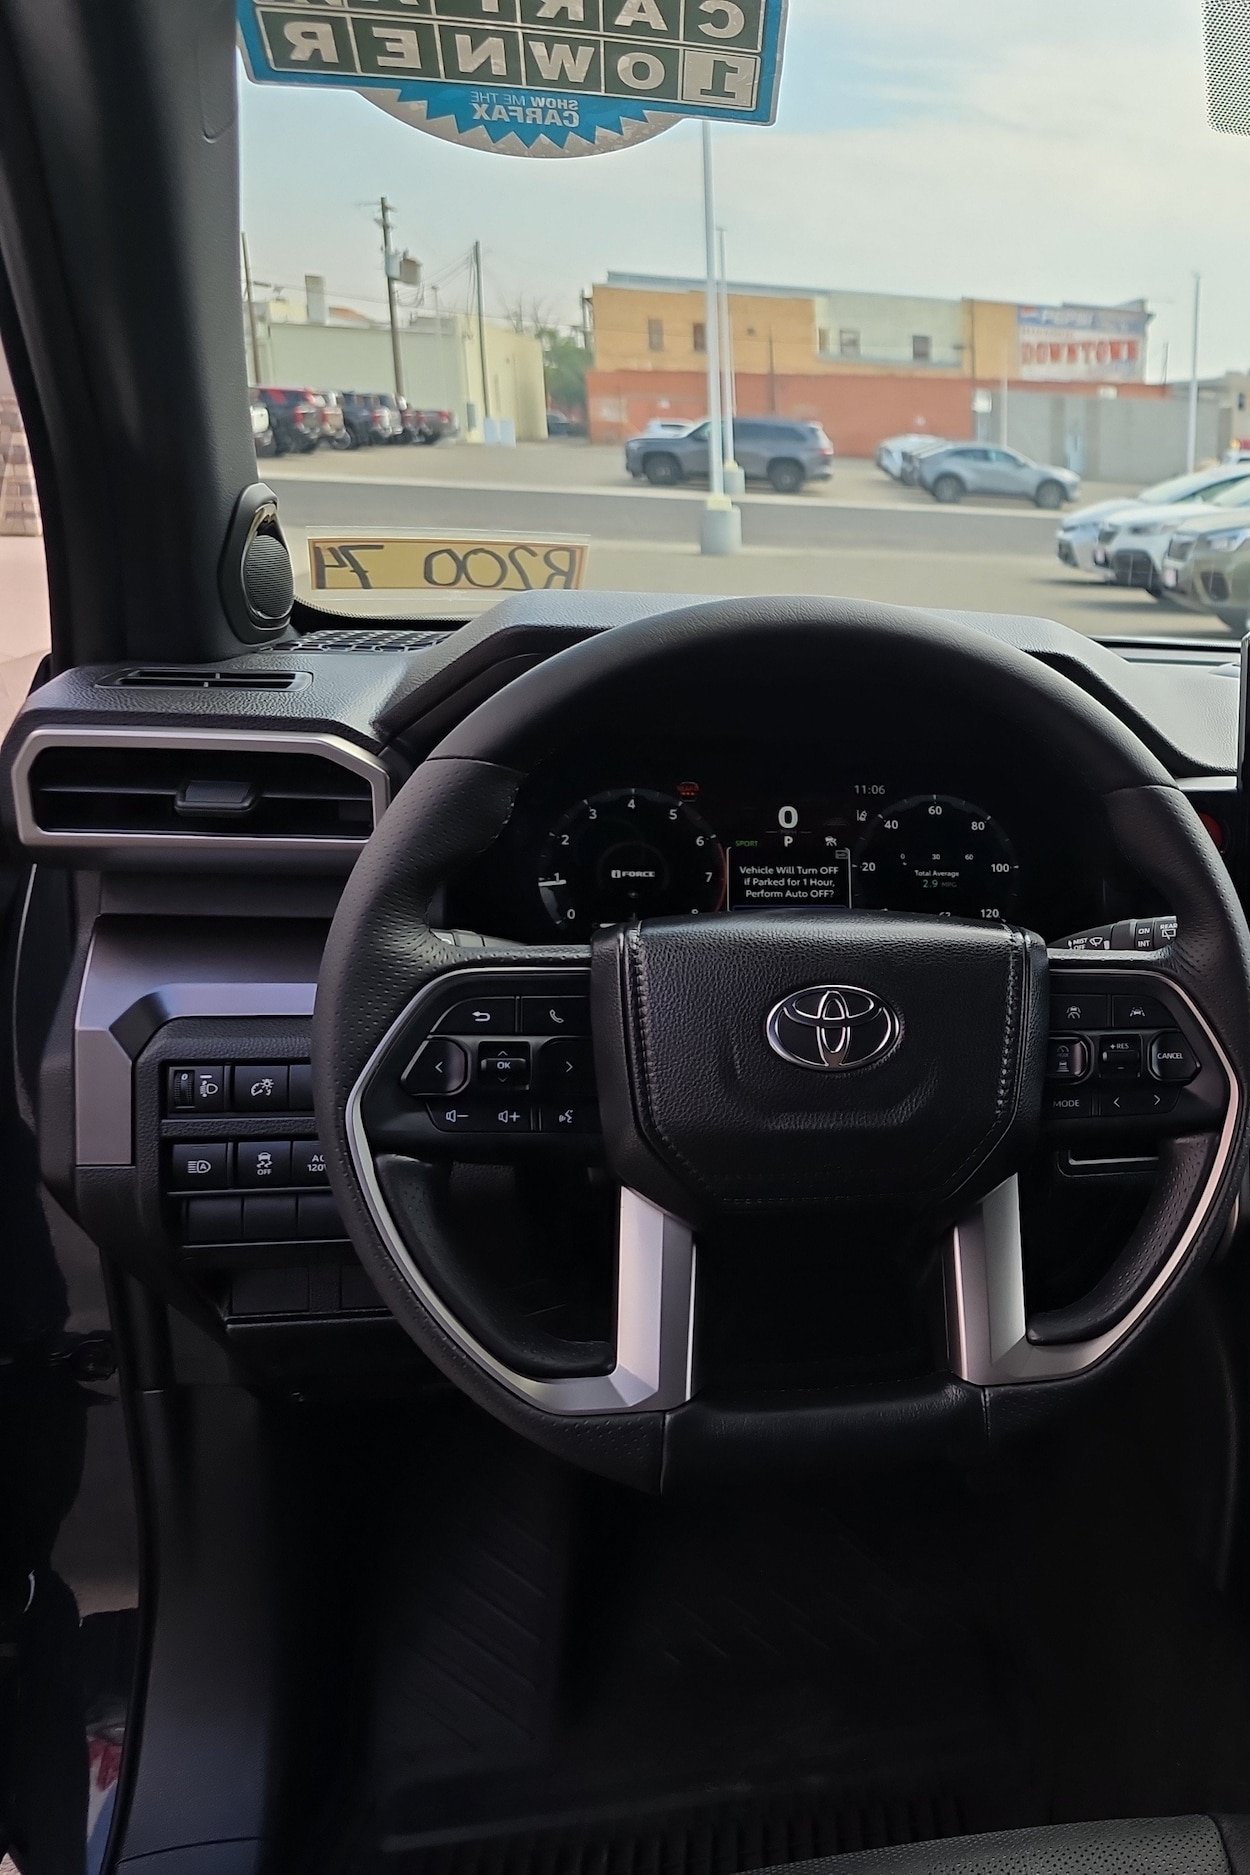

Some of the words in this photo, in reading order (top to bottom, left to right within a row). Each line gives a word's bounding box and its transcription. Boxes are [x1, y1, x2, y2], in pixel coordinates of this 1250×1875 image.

[854, 784, 885, 795] 11:06
[627, 799, 636, 809] 4
[589, 809, 597, 820] 3
[669, 809, 677, 820] 5
[928, 806, 942, 815] 60
[778, 805, 798, 828] 0
[884, 820, 898, 829] 40
[971, 821, 985, 831] 80
[561, 834, 570, 845] 2
[696, 836, 704, 846] 6
[784, 836, 793, 847] P
[739, 866, 774, 875] Vehicle
[776, 866, 795, 875] Will
[798, 866, 818, 875] Turn
[820, 866, 840, 875] OFF
[862, 862, 876, 872] 20
[991, 863, 1010, 873] 100
[705, 872, 713, 883] 7
[933, 870, 959, 878] Average
[752, 877, 785, 886] Parked
[787, 877, 800, 886] for
[810, 878, 835, 888] Hour,
[922, 879, 939, 888] 2.9
[745, 889, 782, 898] Perform
[785, 890, 808, 898] Auto
[810, 889, 834, 898] OFF?
[566, 909, 576, 920] 0
[980, 908, 1000, 919] 120
[1072, 937, 1089, 946] MIST
[1157, 1052, 1183, 1060] CANCEL
[496, 1061, 511, 1070] OK
[1053, 1099, 1080, 1108] MODE
